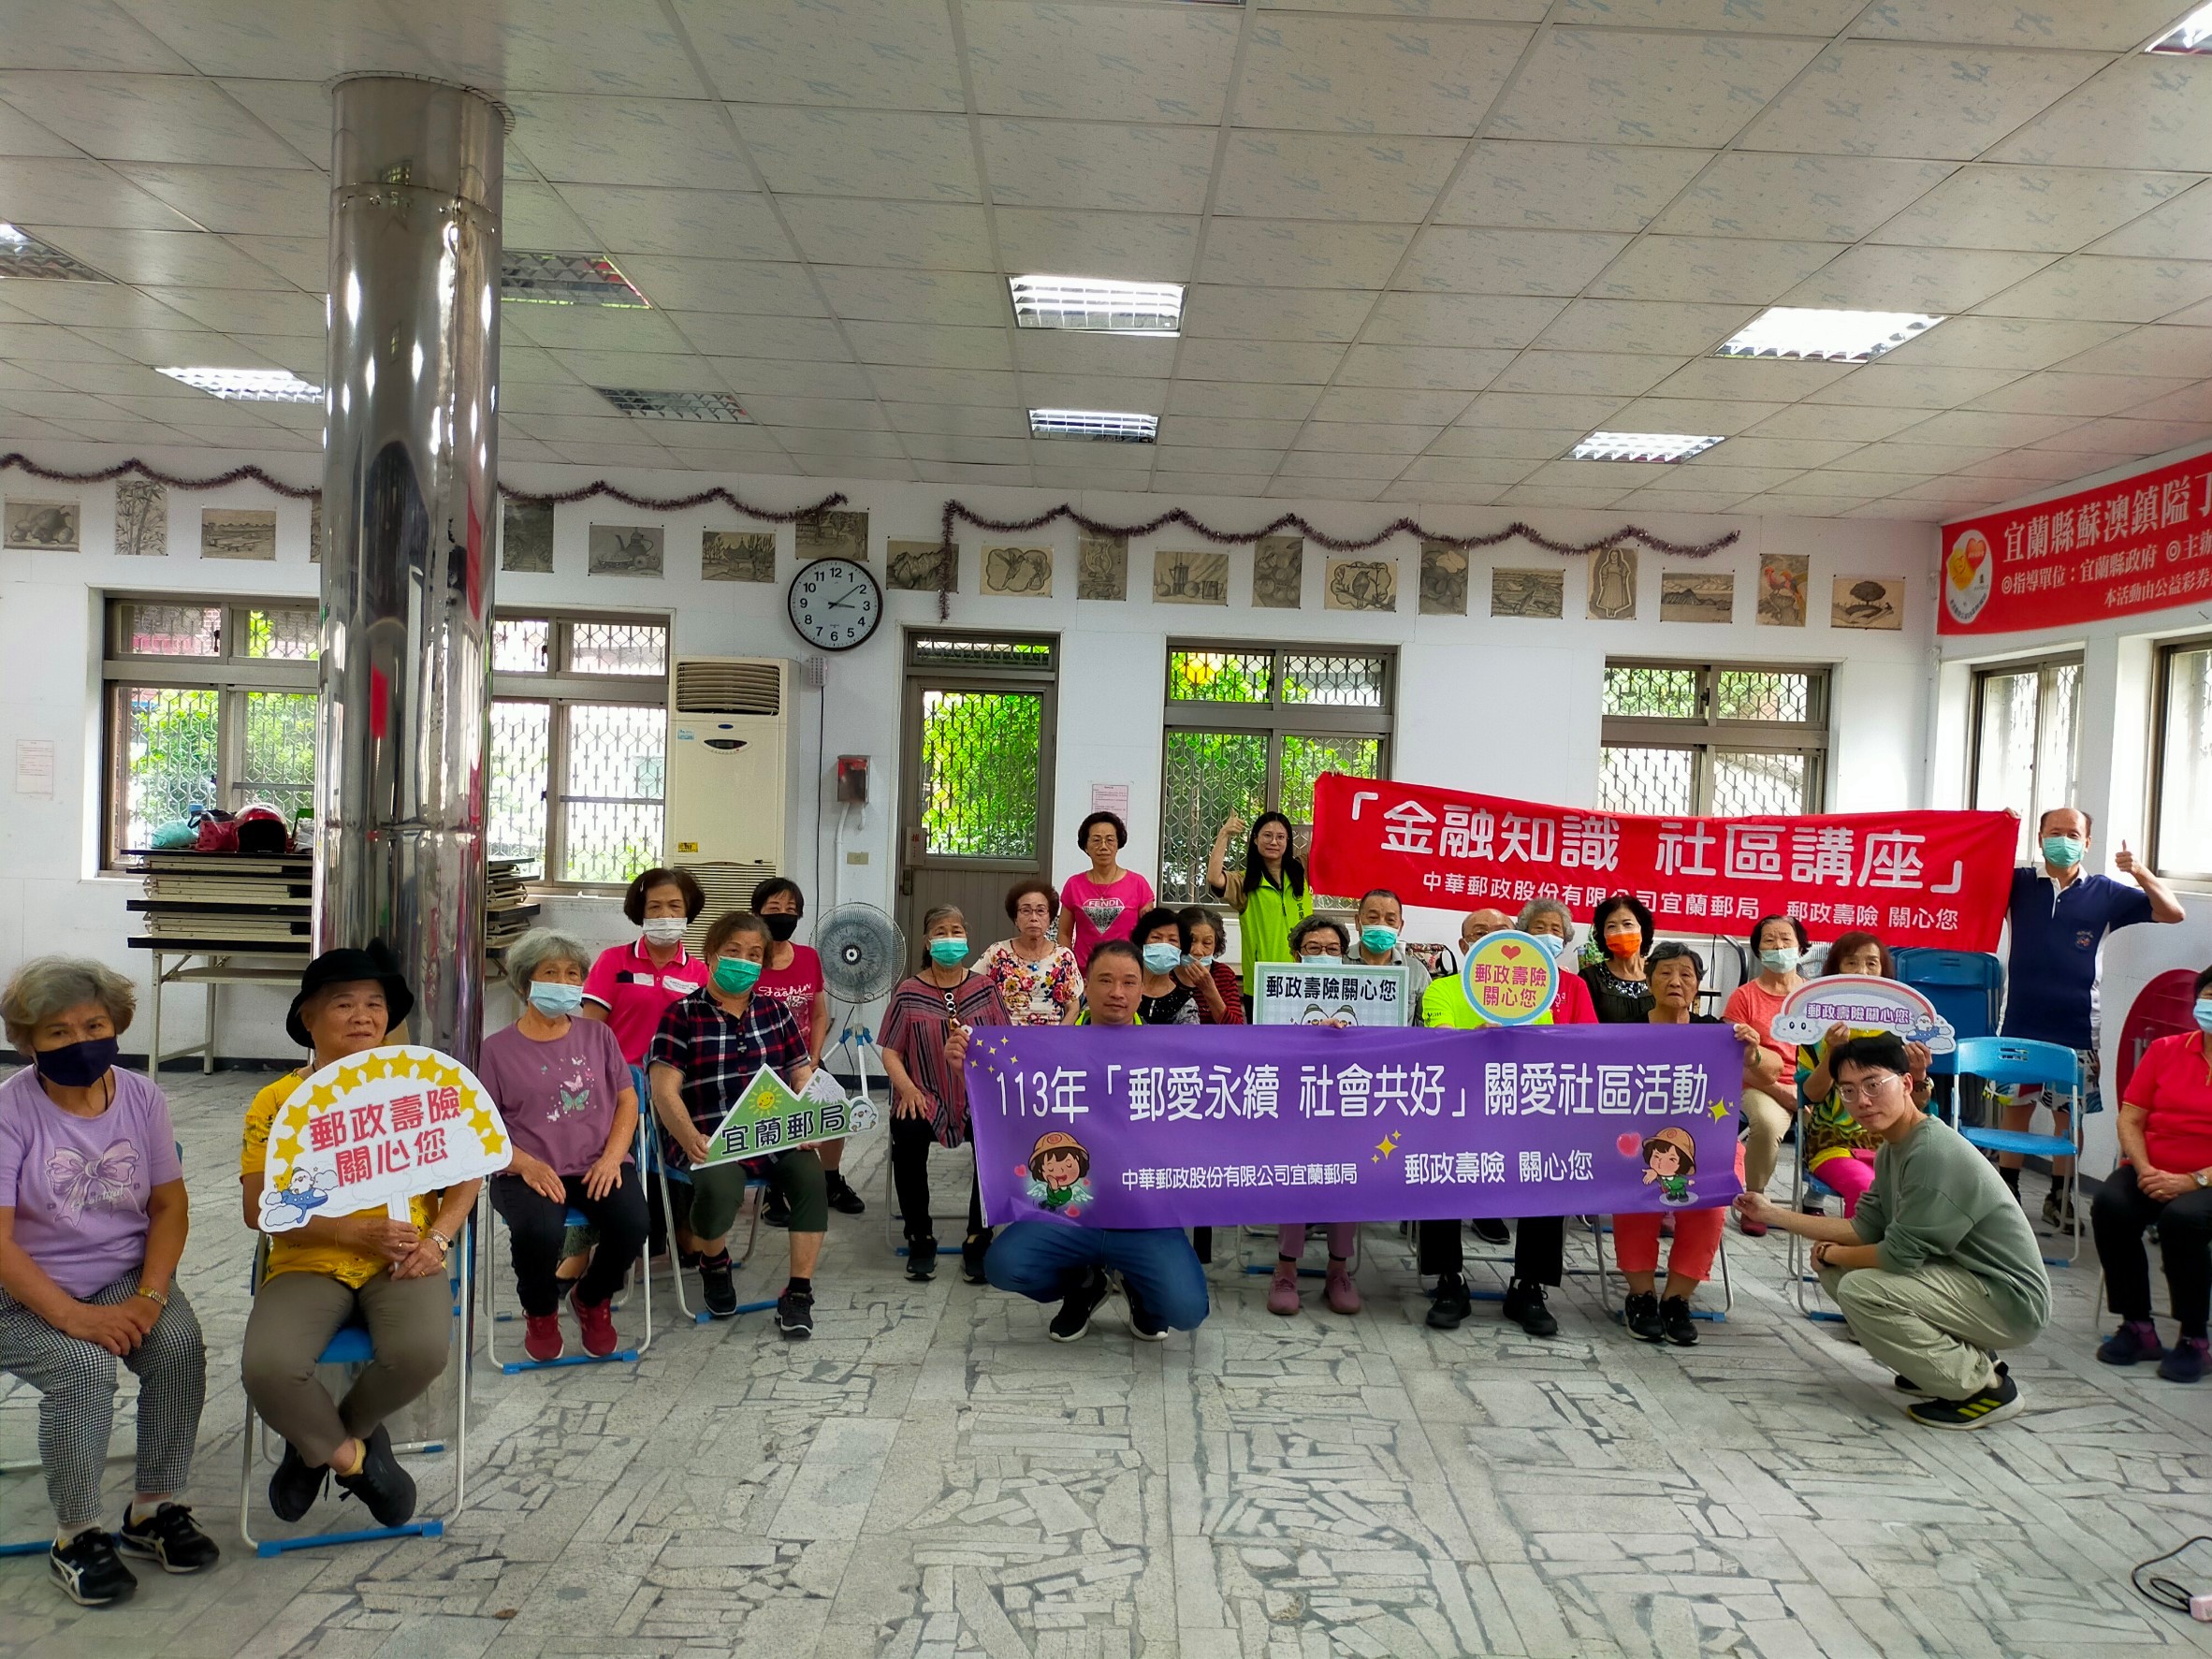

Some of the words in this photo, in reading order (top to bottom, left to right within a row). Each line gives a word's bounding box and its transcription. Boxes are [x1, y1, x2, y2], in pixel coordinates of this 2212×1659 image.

[814, 571, 825, 582] 11
[830, 567, 842, 578] 12
[849, 572, 853, 583] 1
[803, 582, 817, 593] 10
[859, 584, 867, 595] 2
[2103, 567, 2212, 608] 本活動由公益彩券
[799, 598, 808, 609] 9
[863, 600, 871, 612] 3
[804, 614, 813, 625] 8
[857, 616, 866, 627] 4
[815, 626, 823, 637] 7
[830, 631, 839, 642] 6
[847, 627, 855, 638] 5
[1351, 791, 1620, 872] 「金融知識
[1654, 821, 1963, 895] 社區講座」
[1088, 899, 1120, 908] FENDI
[1786, 900, 1879, 928] 郵政壽險
[1888, 907, 1959, 932] 關心您
[1475, 964, 1547, 988] 郵政壽險
[1266, 975, 1397, 1002] 郵政壽險關心您
[1483, 989, 1536, 1009] 關心您
[1805, 1002, 1911, 1025] 郵政壽險關心您
[309, 1085, 462, 1153] 郵政壽險
[720, 1104, 847, 1157] 宜蘭郵局
[335, 1128, 448, 1187] 關心您
[1122, 1162, 1358, 1191] 中華郵政股份有限公司宜蘭郵局
[1404, 1151, 1506, 1186] 郵政壽險
[1518, 1149, 1594, 1183] 關心您
